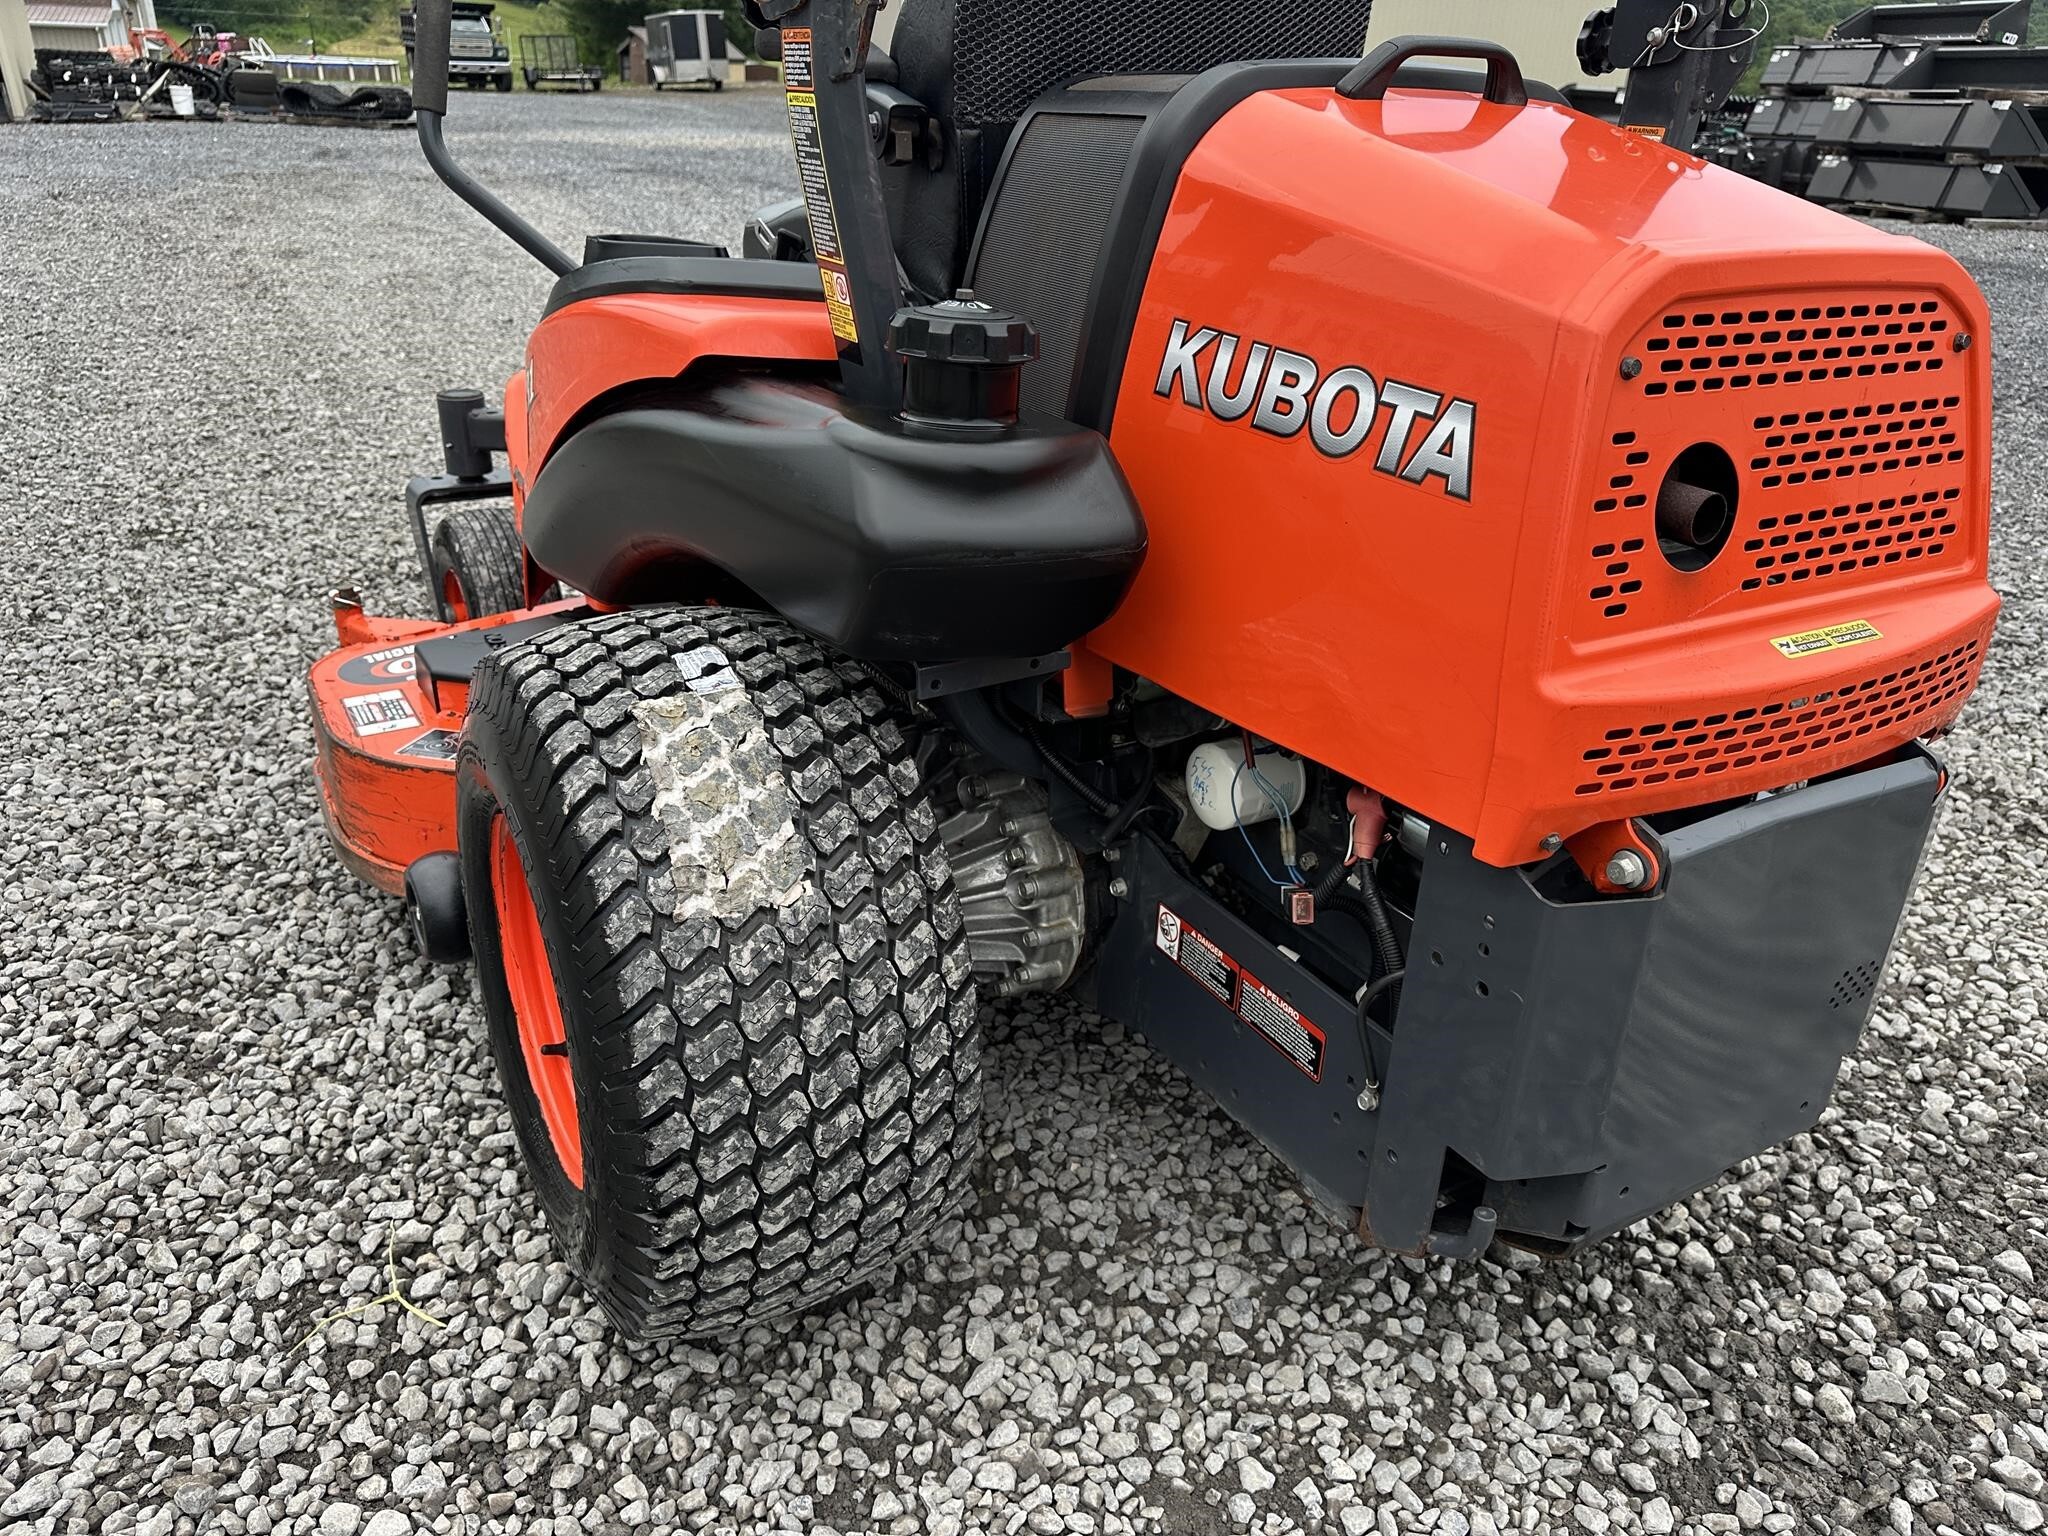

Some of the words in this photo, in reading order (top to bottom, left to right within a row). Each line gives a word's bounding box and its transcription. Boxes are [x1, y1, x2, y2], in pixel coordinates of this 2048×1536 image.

[1632, 127, 1659, 135] WARNING
[1153, 317, 1477, 503] KUBOTA
[1197, 933, 1224, 960] DANGER
[1266, 989, 1300, 1021] PELIGRO
